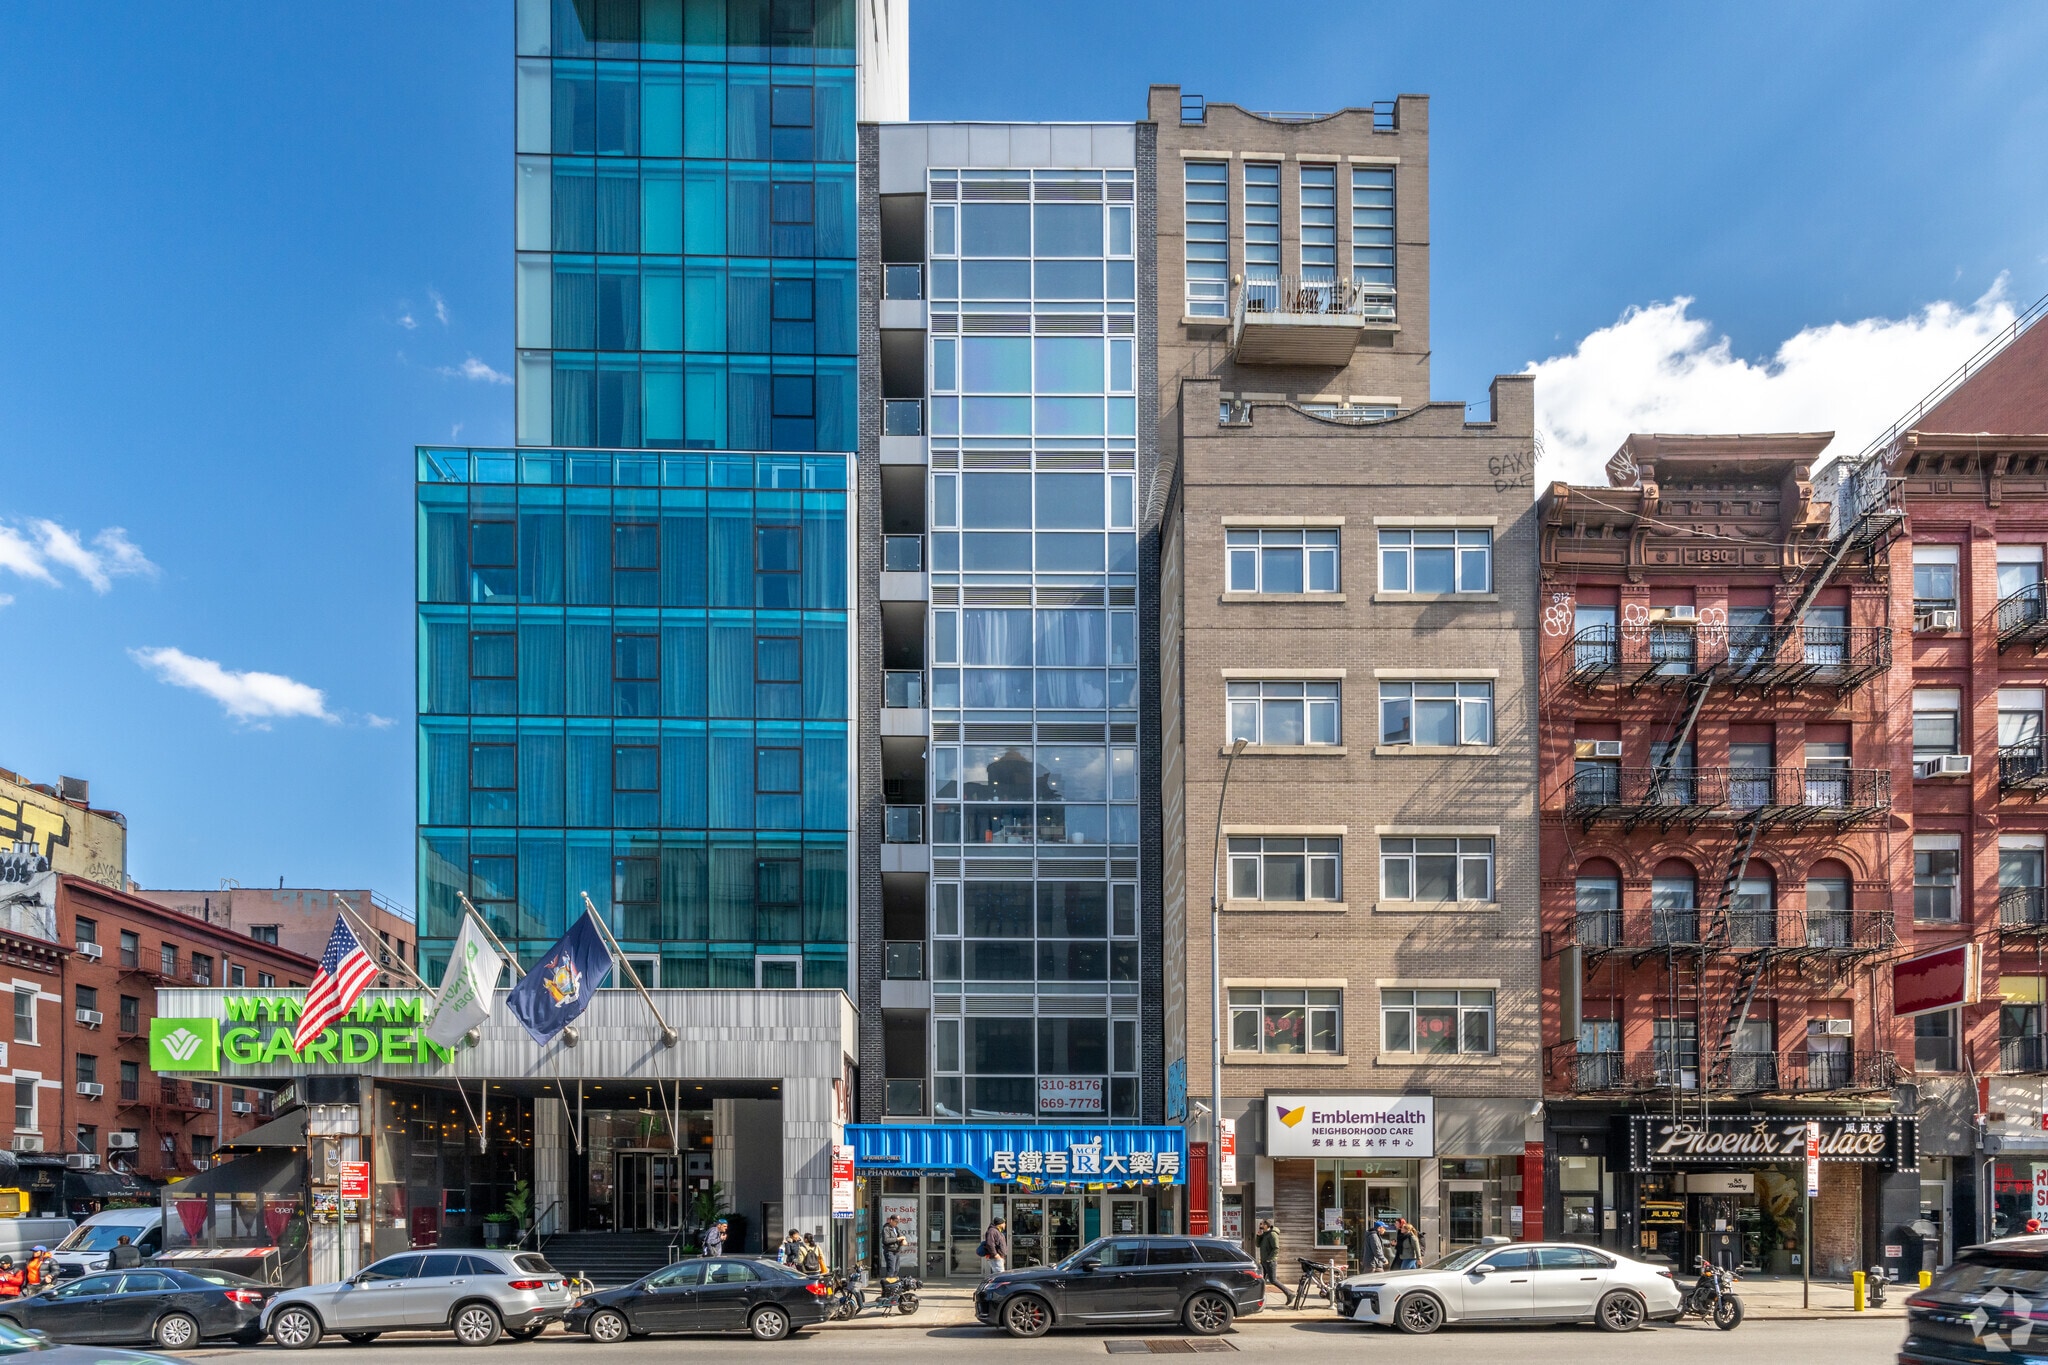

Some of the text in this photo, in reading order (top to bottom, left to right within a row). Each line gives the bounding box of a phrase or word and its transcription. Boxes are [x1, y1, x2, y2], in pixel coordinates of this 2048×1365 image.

[1697, 549, 1729, 562] 1890
[222, 996, 424, 1023] WYNHAM
[222, 1027, 455, 1064] GARDEN
[1041, 1080, 1100, 1090] 310-8176
[1041, 1098, 1100, 1108] 669-7778
[1312, 1110, 1425, 1124] EmblemHealth
[1312, 1138, 1413, 1147] 安保社区关怀中心
[1657, 1123, 1780, 1153] Phoenix
[992, 1151, 1069, 1173] 民鐵吾
[1103, 1151, 1180, 1174] 大藥房
[1366, 1163, 1382, 1173] 87
